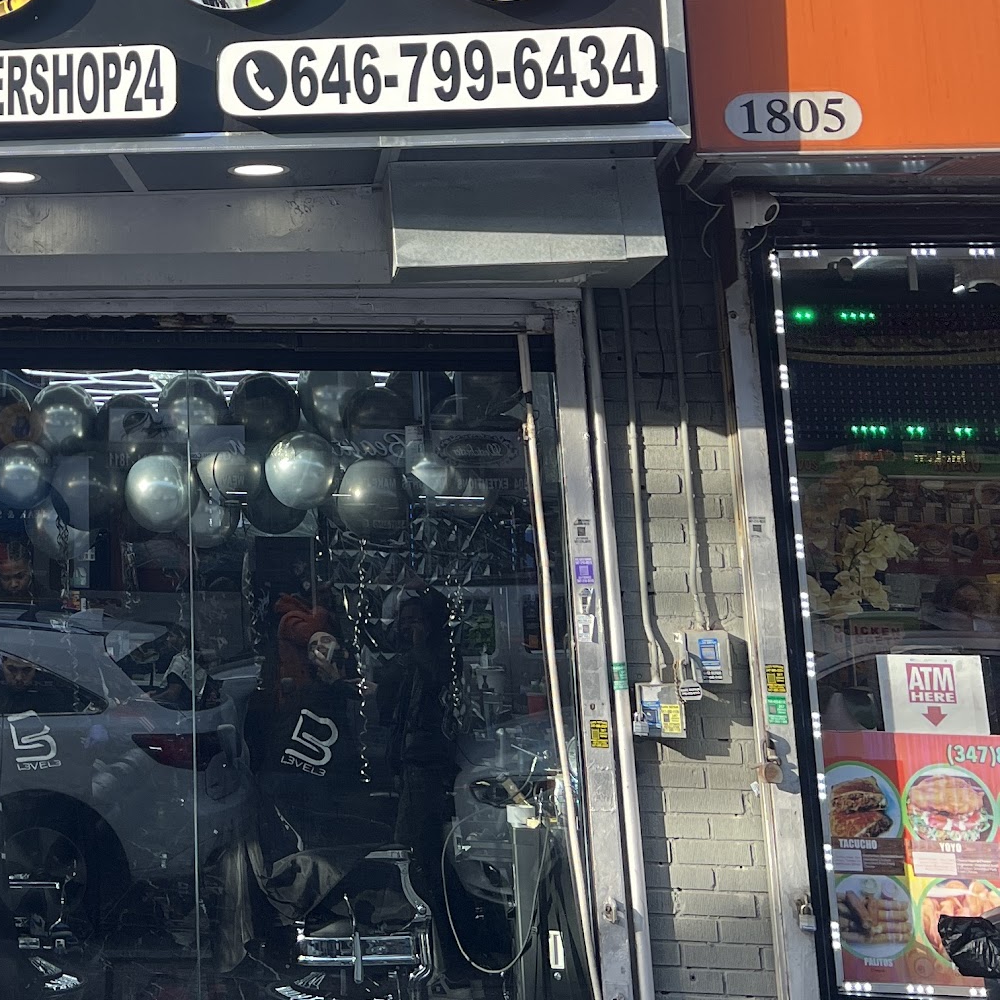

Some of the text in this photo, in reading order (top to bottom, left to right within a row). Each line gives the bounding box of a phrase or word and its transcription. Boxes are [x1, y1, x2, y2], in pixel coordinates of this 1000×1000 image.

[291, 33, 644, 106] 646-799-6434
[740, 97, 847, 135] 1805
[909, 666, 954, 691] ATM
[911, 692, 955, 703] HERE
[838, 838, 878, 850] TACUCHO
[939, 842, 962, 853] YOYO
[863, 957, 894, 967] PALITOS
